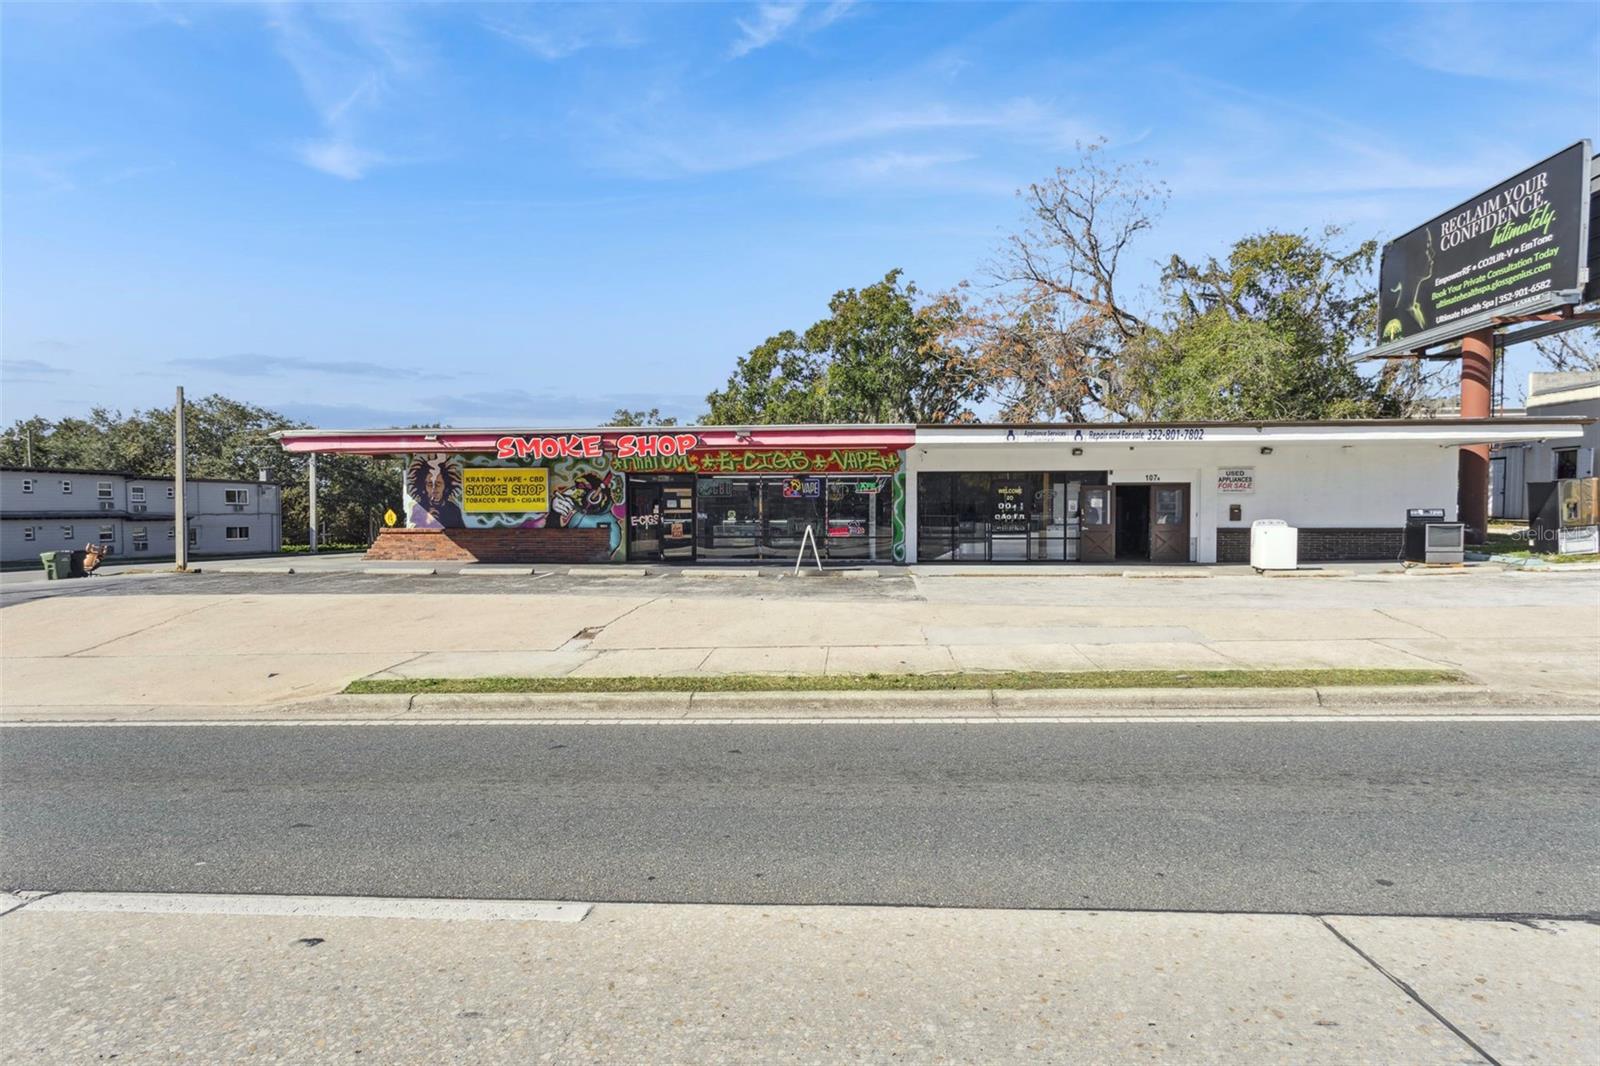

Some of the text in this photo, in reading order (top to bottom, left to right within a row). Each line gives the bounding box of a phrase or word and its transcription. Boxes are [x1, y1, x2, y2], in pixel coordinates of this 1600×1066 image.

[1440, 172, 1549, 237] RECLAIM YOUR
[1440, 189, 1548, 251] CONFIDENCE.
[1490, 202, 1556, 248] Intimately.
[1520, 234, 1554, 252] EmTone
[1431, 247, 1559, 300] Book Your Private Consultation Today
[1435, 279, 1552, 324] Ultimate Health Spa 352-901-6582
[1024, 430, 1047, 438] Appliance
[1089, 429, 1204, 440] Repair and For sale 352-801-7802
[497, 434, 697, 459] SMOKE SHOP
[717, 451, 810, 471] E-CIGS
[828, 450, 887, 470] VAPE
[466, 484, 546, 496] SMOKE SHOP
[801, 482, 818, 494] VAPE
[631, 514, 660, 526] E-CIGS
